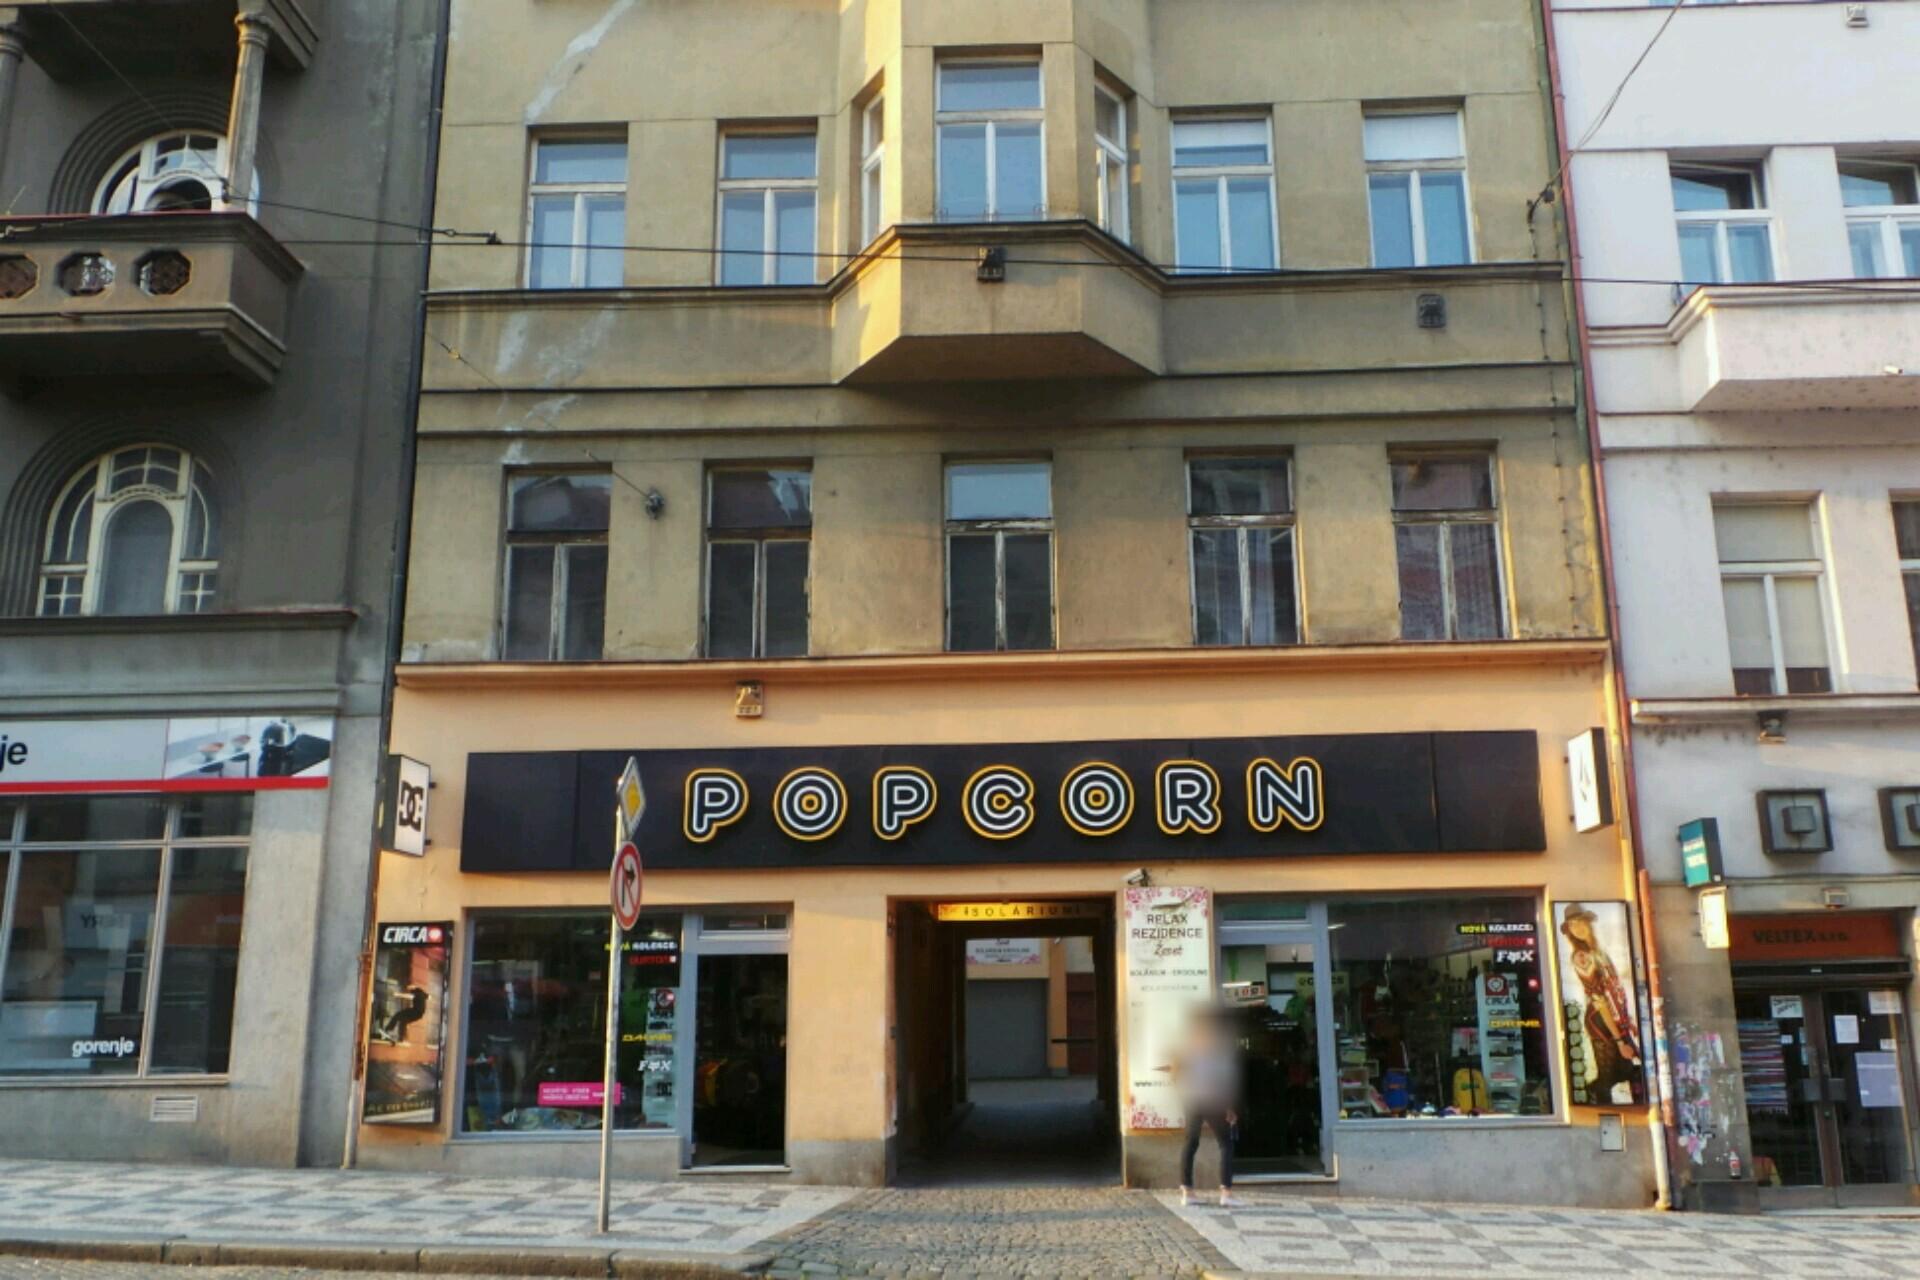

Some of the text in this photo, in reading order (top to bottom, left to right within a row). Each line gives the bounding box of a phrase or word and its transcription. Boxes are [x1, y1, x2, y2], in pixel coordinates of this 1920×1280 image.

[683, 757, 1324, 843] POPCORN
[1146, 913, 1188, 925] RELAX
[1131, 927, 1203, 939] REZIDENCE
[72, 1036, 135, 1058] gorenje
